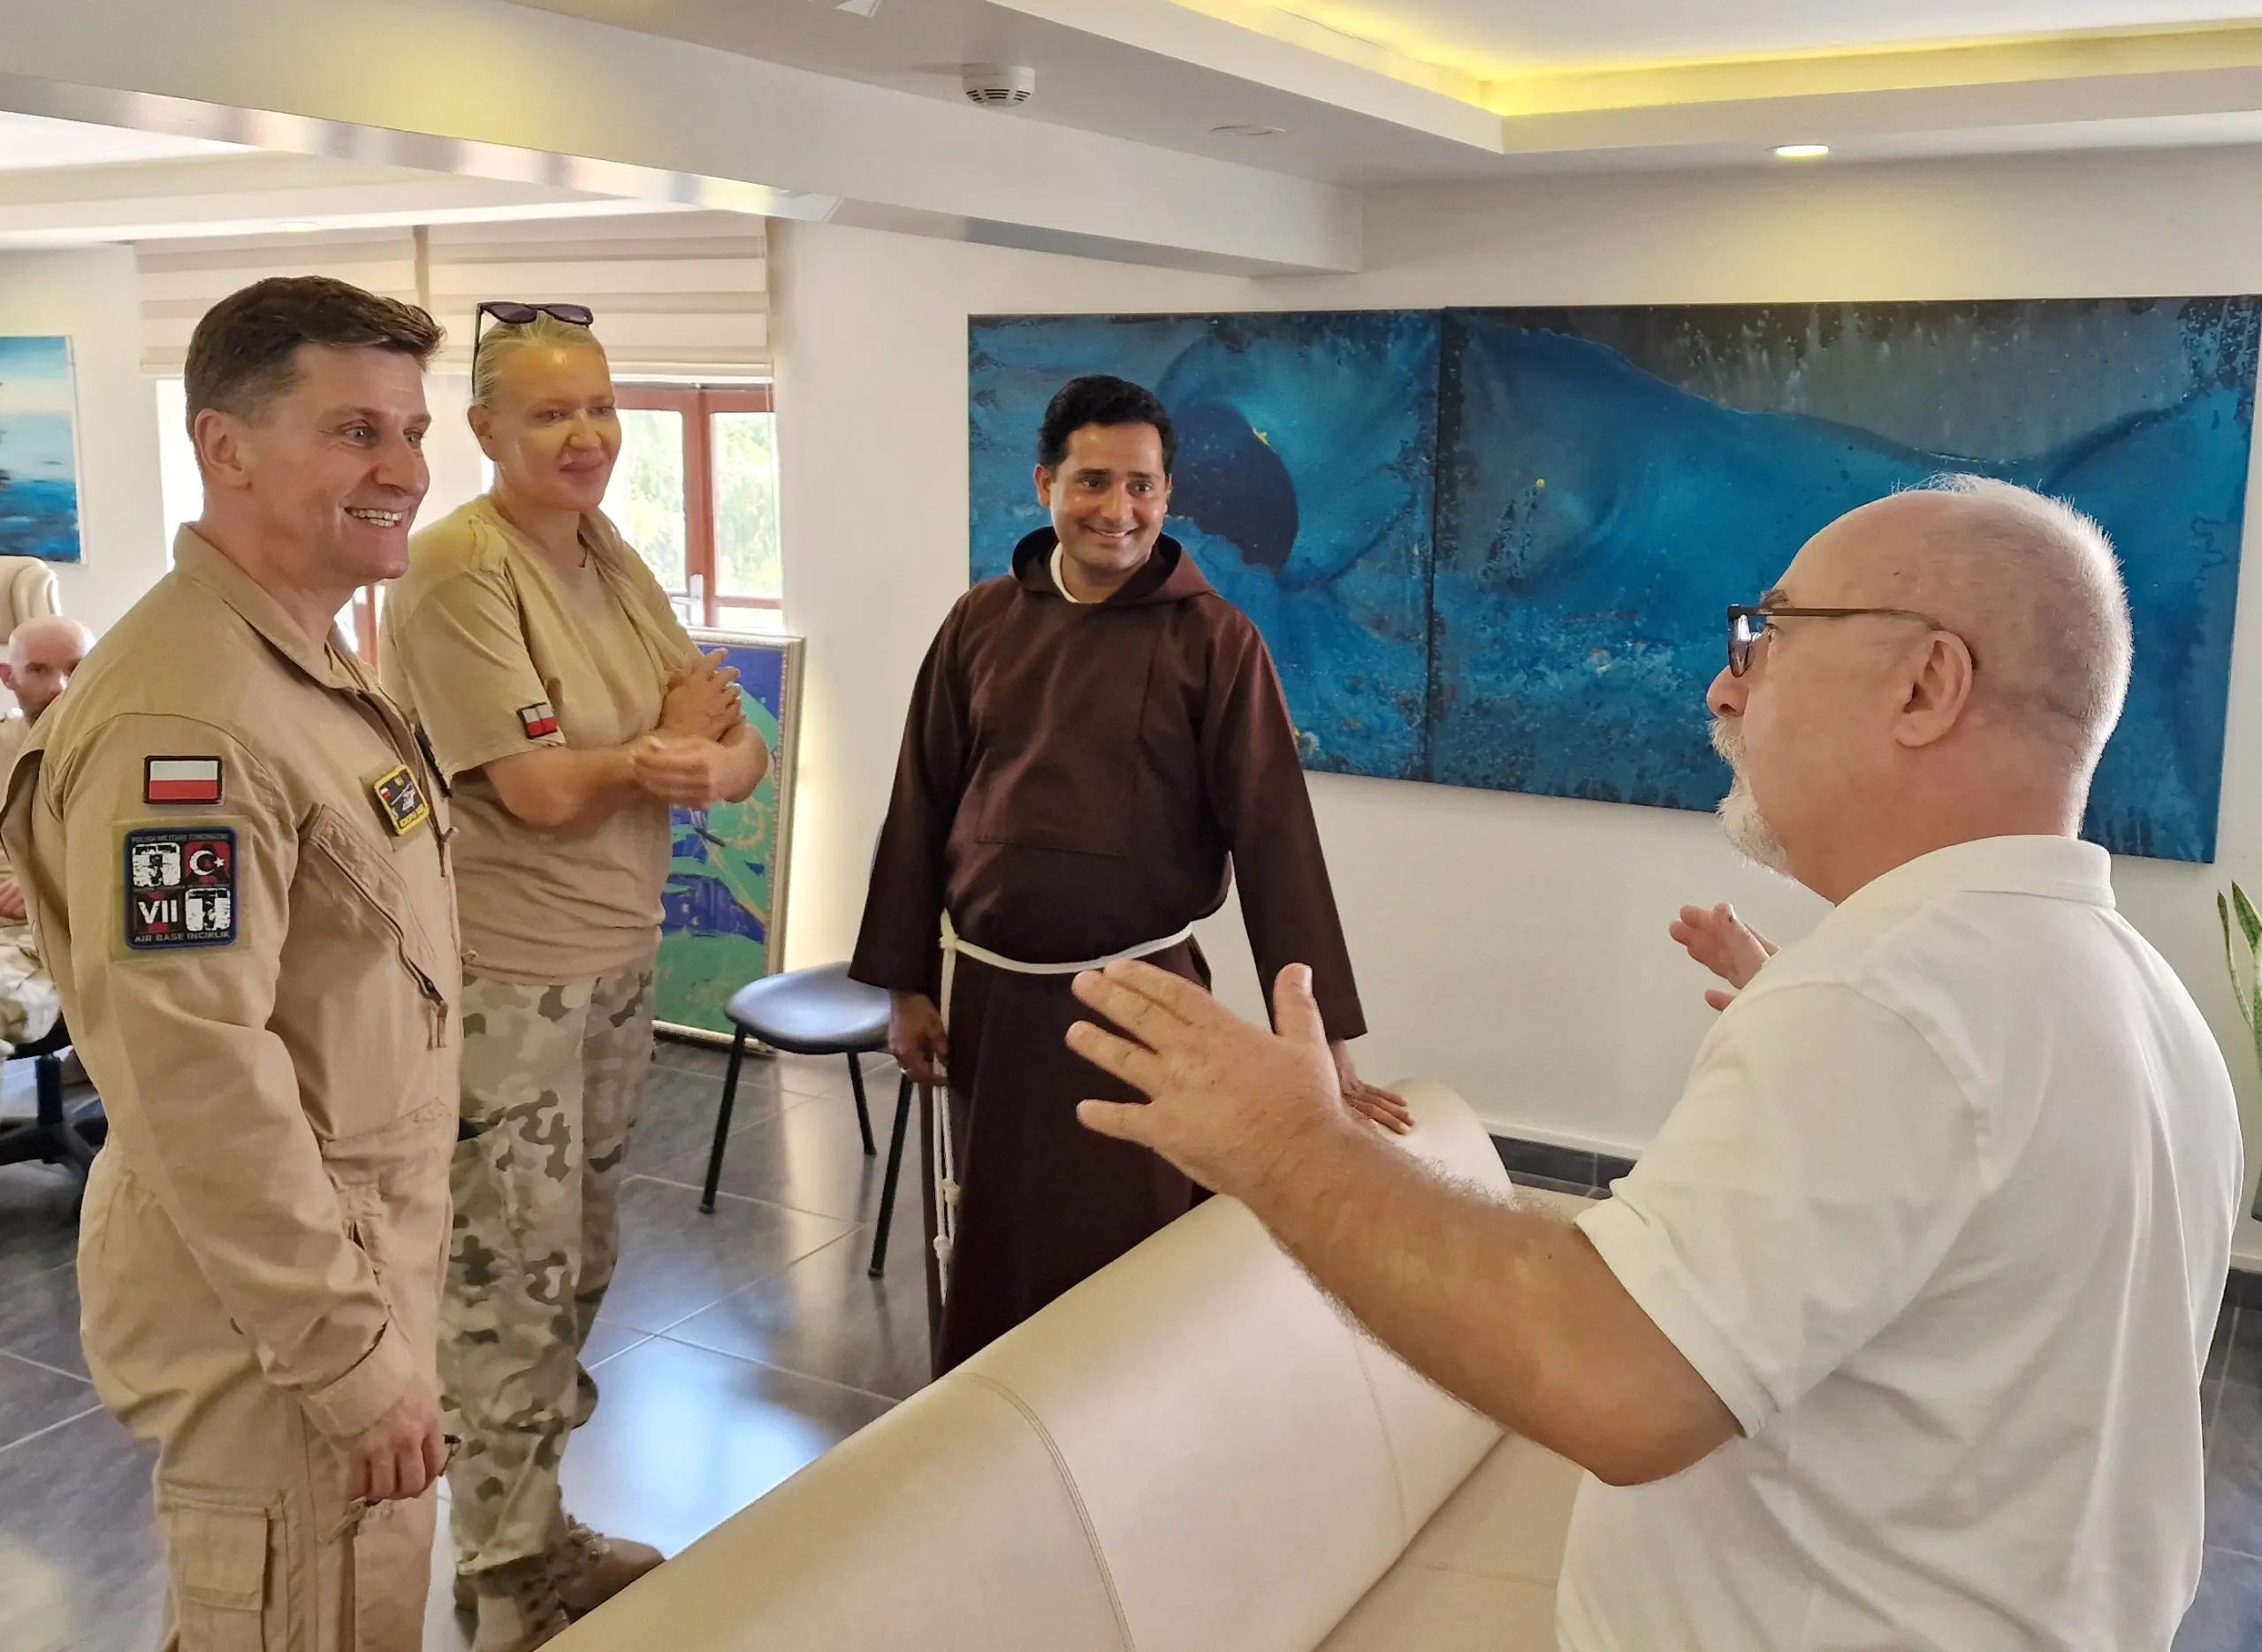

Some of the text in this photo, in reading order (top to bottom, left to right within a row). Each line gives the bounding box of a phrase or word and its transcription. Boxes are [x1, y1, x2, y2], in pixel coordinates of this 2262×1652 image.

[138, 899, 178, 925] VII
[134, 934, 152, 943] AIR
[155, 933, 184, 942] BASE
